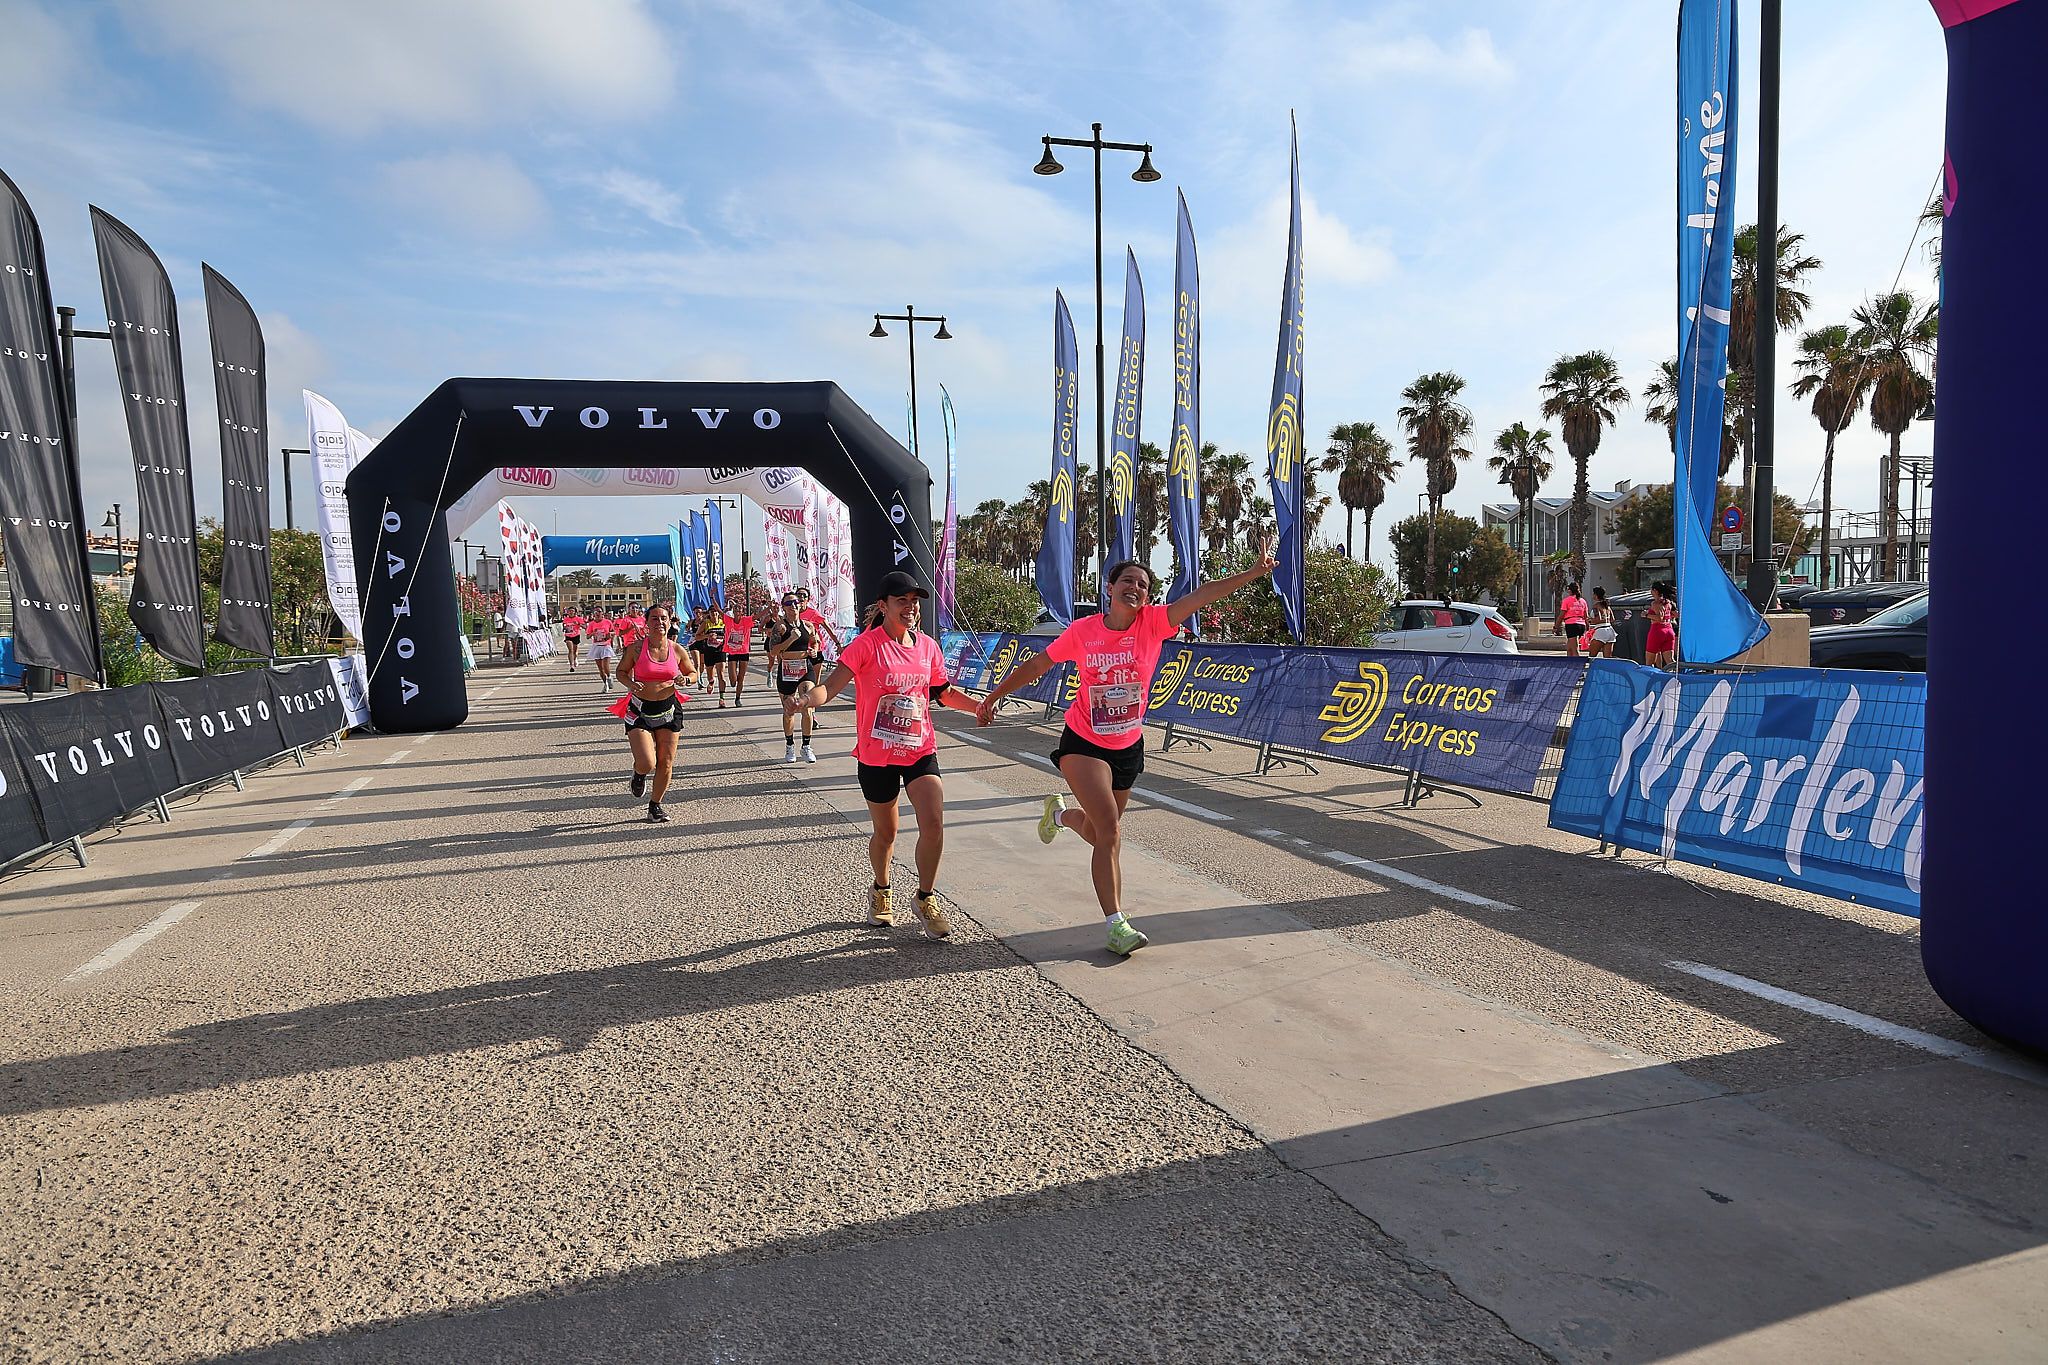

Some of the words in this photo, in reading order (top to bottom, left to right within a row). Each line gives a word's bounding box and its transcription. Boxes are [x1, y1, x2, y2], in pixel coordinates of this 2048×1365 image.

[513, 405, 781, 429] VOLVO
[585, 538, 640, 562] Marlene
[384, 511, 419, 705] VOLVO
[1086, 650, 1134, 668] CARRERA
[1194, 656, 1255, 684] Correos
[1177, 682, 1240, 715] Express
[1403, 674, 1498, 713] Correos
[892, 716, 912, 727] 016
[1107, 705, 1128, 716] 016
[35, 723, 161, 783] VOLVO
[176, 699, 270, 741] VOLVO
[279, 684, 335, 715] VOLVO
[1383, 712, 1480, 757] Express
[1608, 677, 1924, 895] Marlen
